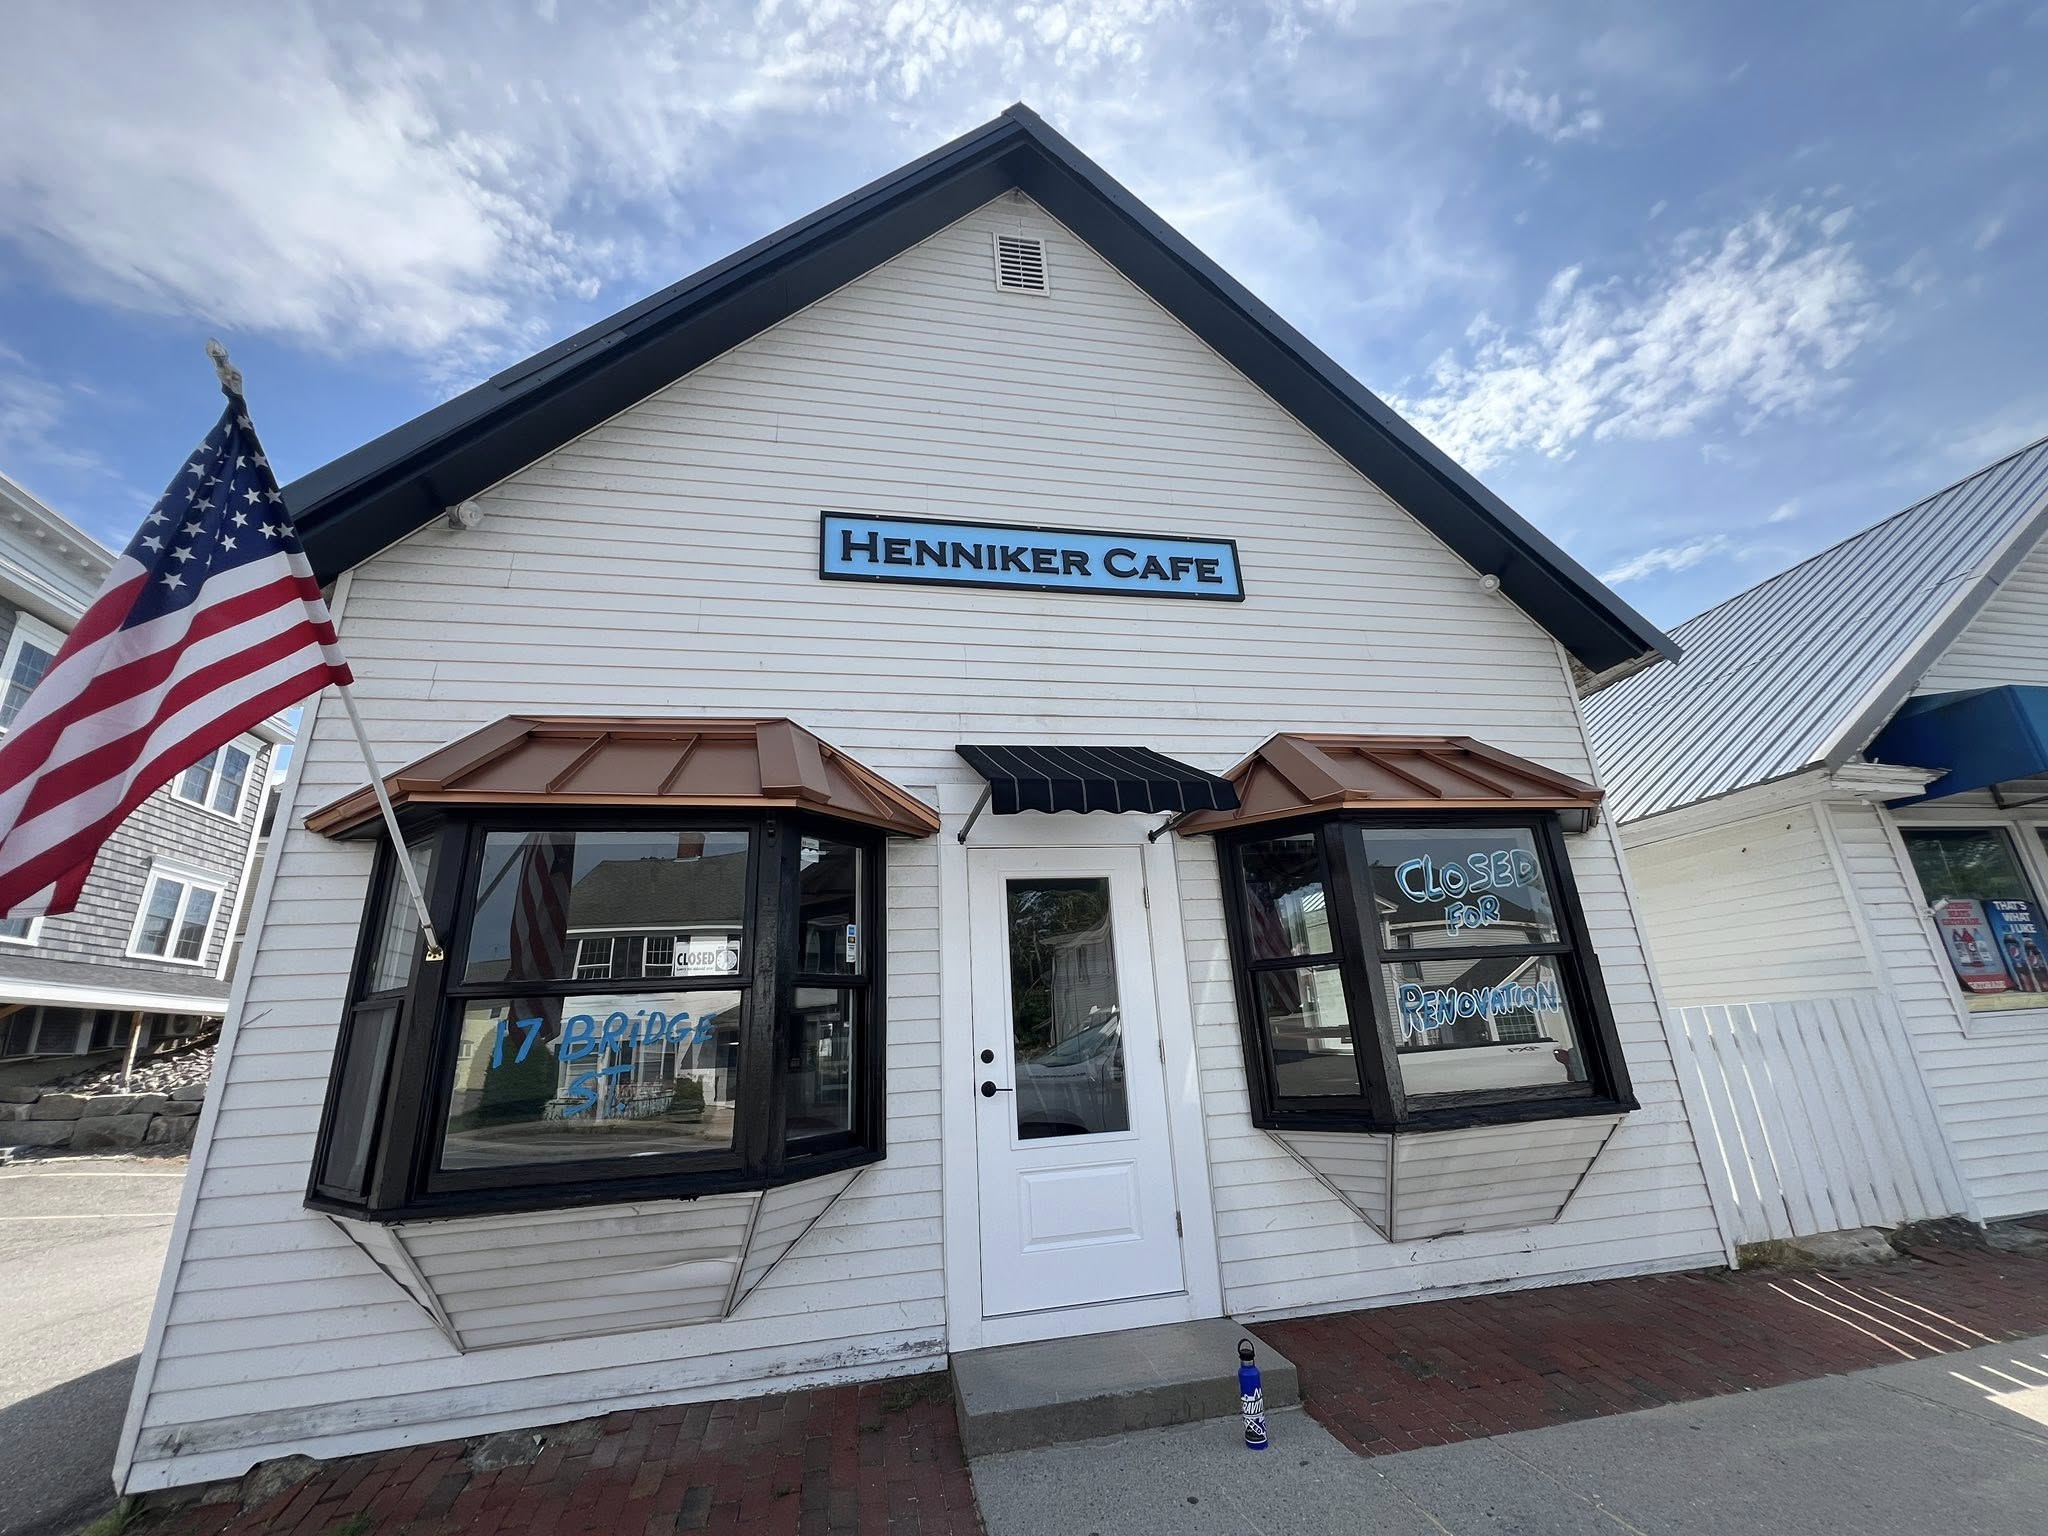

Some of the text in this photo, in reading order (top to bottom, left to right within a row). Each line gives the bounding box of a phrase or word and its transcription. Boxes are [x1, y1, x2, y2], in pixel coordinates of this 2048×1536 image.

[840, 529, 1223, 583] HENNIKER CAFE
[1395, 849, 1539, 903] CLOSED
[1445, 895, 1500, 936] FOR
[1992, 901, 2027, 911] THAT'S
[2002, 912, 2030, 922] WHAT
[2015, 924, 2037, 933] LIKE
[677, 952, 715, 966] CLOSED
[1396, 981, 1559, 1038] RENOVATION
[492, 1018, 544, 1069] 17
[563, 1064, 636, 1118] ST.
